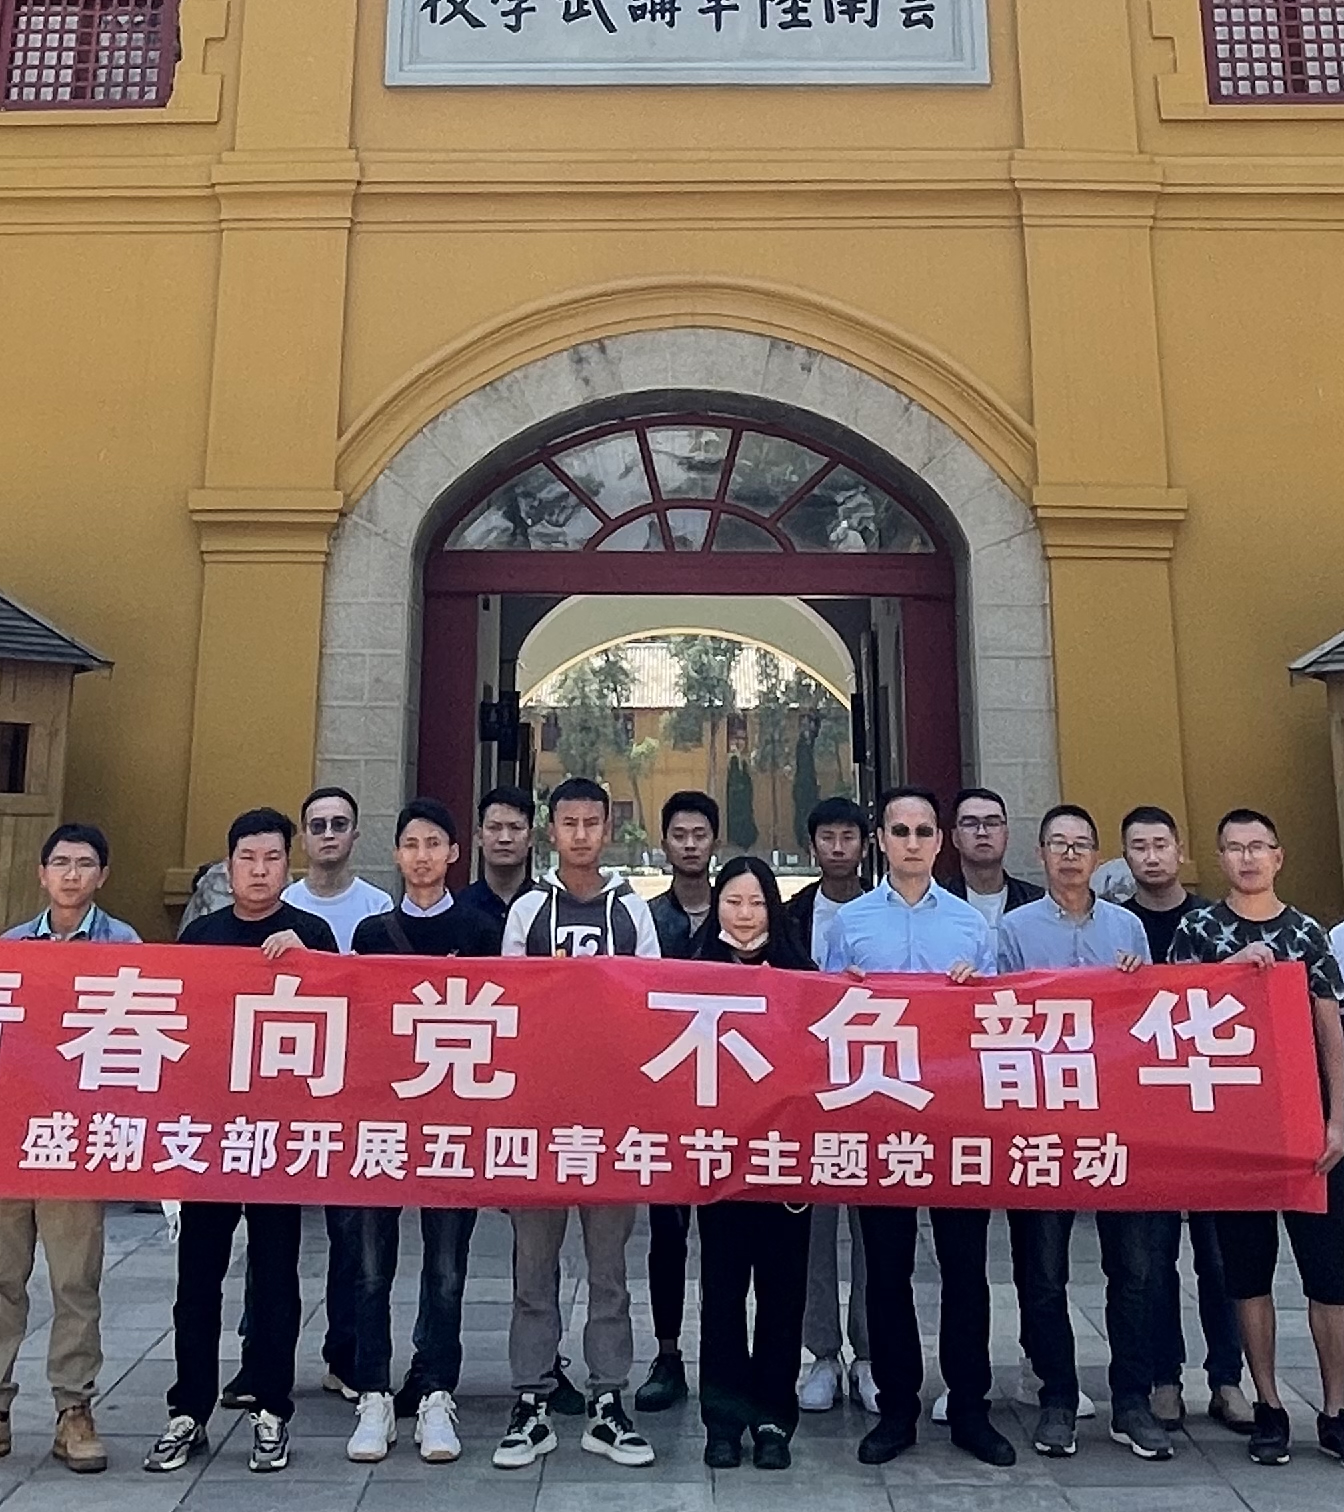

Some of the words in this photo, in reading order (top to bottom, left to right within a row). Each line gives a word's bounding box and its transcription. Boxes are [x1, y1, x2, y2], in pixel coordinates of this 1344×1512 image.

[641, 989, 1261, 1113] 不负韶华
[19, 1112, 1129, 1187] 盛翔支部开展五四青年节主题党日活动
